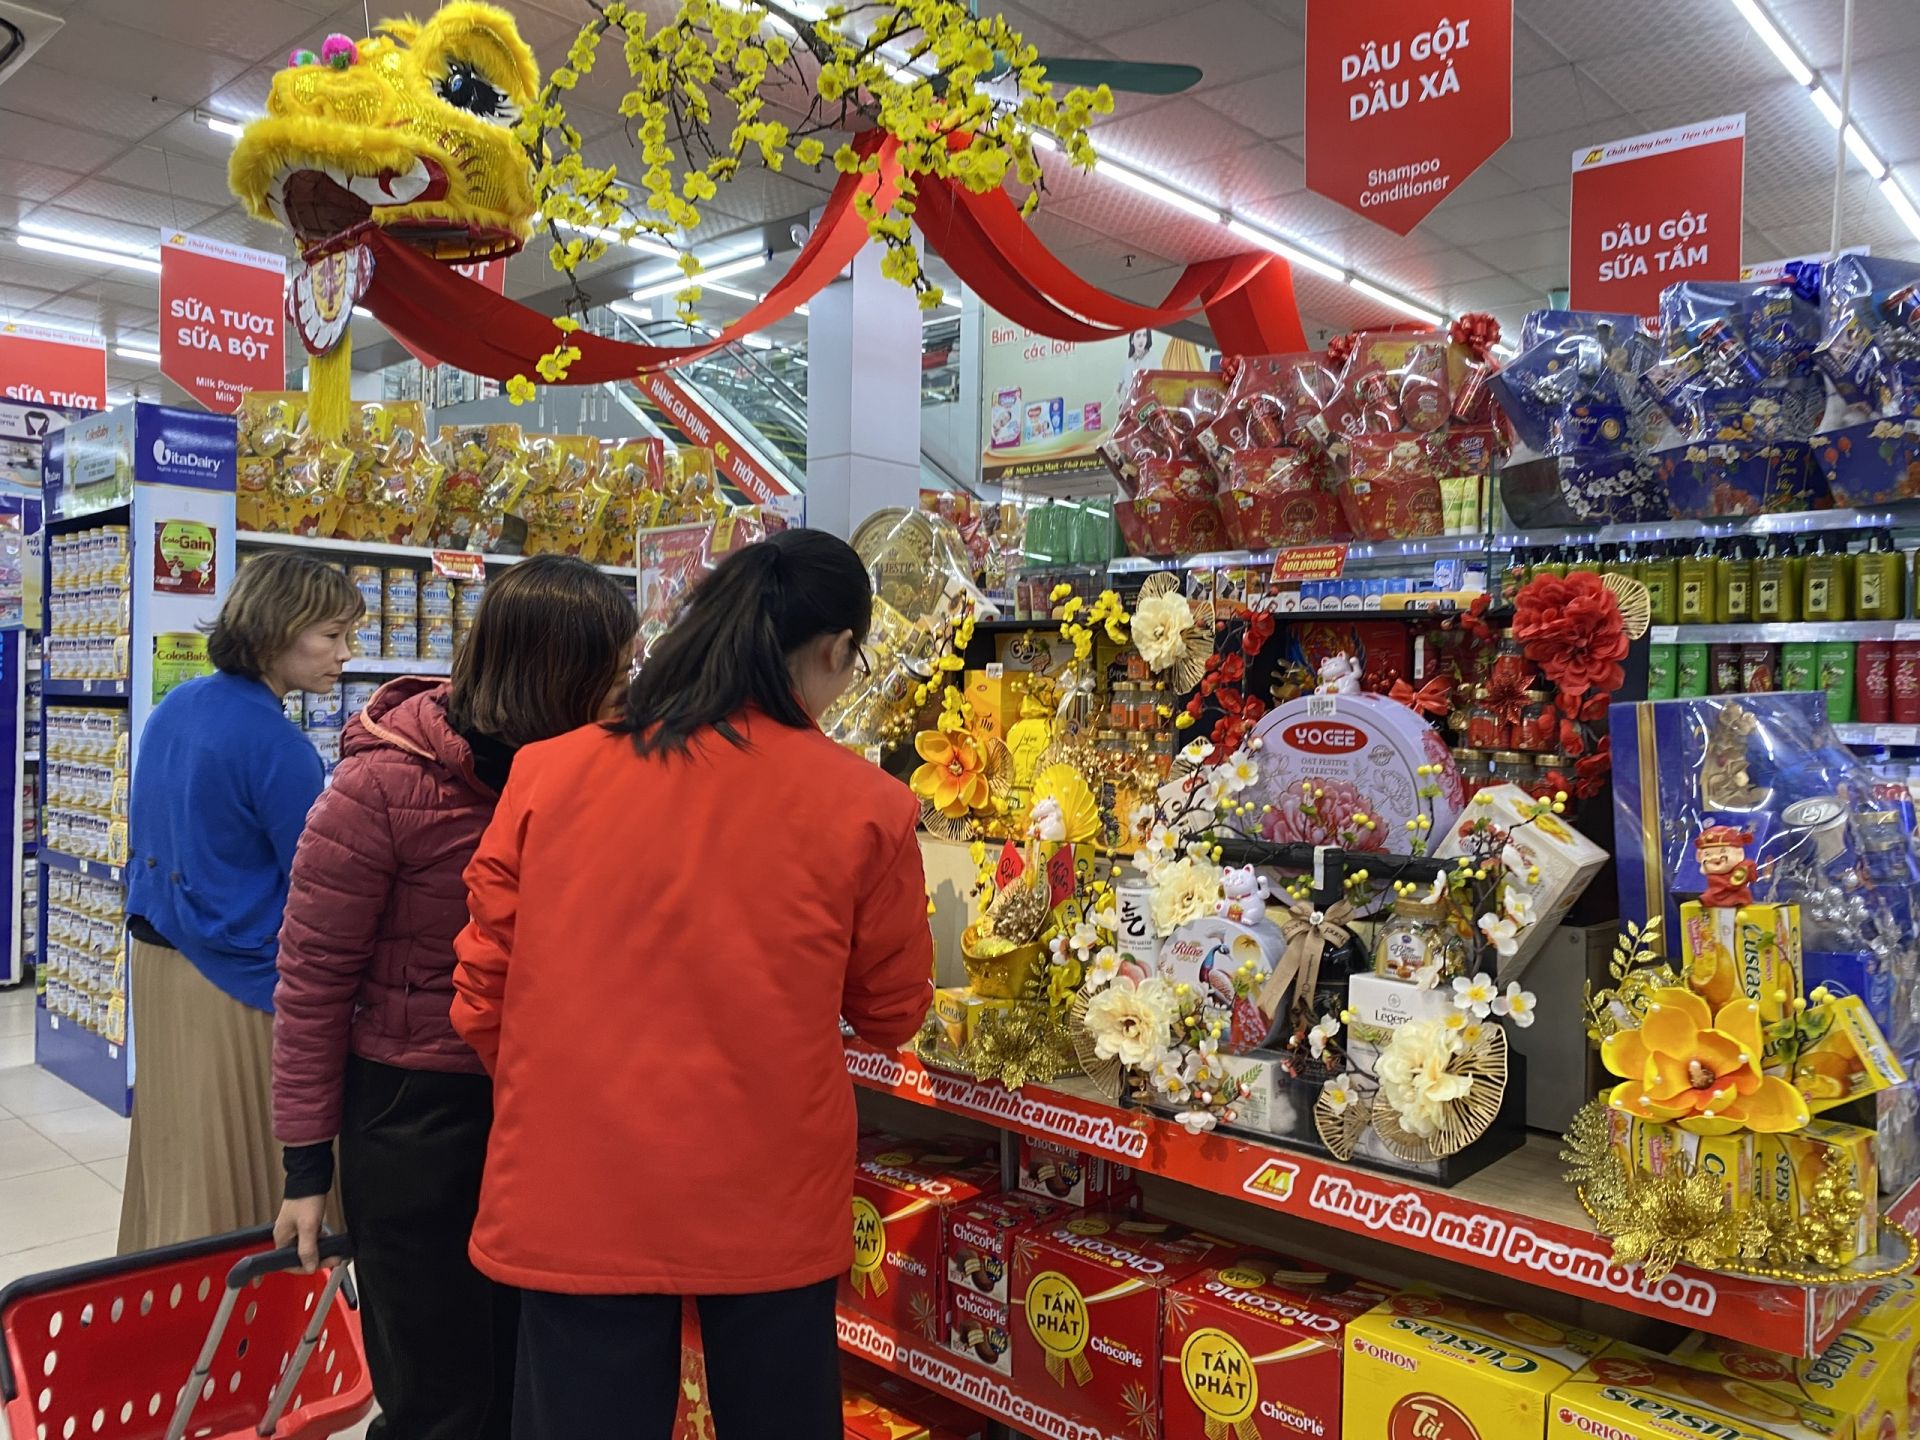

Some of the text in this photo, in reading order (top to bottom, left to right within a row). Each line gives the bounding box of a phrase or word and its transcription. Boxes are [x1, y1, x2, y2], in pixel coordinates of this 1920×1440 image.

[1341, 17, 1470, 83] DẦU GỘI
[1349, 58, 1461, 122] DẦU XẢ
[1368, 157, 1441, 188] Shampoo
[1359, 175, 1451, 208] Conditioner
[1601, 209, 1708, 252] DẦU GỘI
[1598, 243, 1708, 282] SỮA TẮM
[170, 297, 275, 337] SỮA TƯƠI
[178, 325, 270, 362] SỮA BỘT
[1023, 343, 1047, 360] các
[5, 383, 98, 410] SỮA TƯƠI
[196, 375, 254, 393] Milk Powder
[215, 390, 236, 404] Milk
[651, 378, 711, 445] HÀNG GIA DỤNG
[731, 457, 777, 502] THỜI TRAN
[1295, 728, 1356, 747] YOGEE
[1300, 767, 1350, 776] COLLECTION
[1375, 1009, 1413, 1025] Legen
[844, 1049, 905, 1087] motion
[917, 1070, 1148, 1159] www.minhcaumart.vn
[854, 1213, 876, 1235] ẤN
[952, 1222, 1003, 1254] ChocoPie
[853, 1233, 879, 1253] HÁT
[1052, 1230, 1166, 1274] ChocoPie
[1310, 1174, 1431, 1239] Khuyến
[1432, 1210, 1504, 1258] mãi
[1503, 1224, 1717, 1317] Promotion
[886, 1251, 928, 1278] ChocoPie
[955, 1293, 1007, 1327] ChocoPie
[1041, 1290, 1076, 1316] TẤN
[1205, 1281, 1342, 1333] ChocoPie
[1231, 1301, 1280, 1323] ORION
[836, 1315, 896, 1362] motion
[1036, 1312, 1080, 1337] PHÁT
[1090, 1336, 1144, 1369] ChocoPie
[1368, 1346, 1418, 1373] ORION
[1389, 1316, 1542, 1375] Custas
[1424, 1343, 1466, 1362] ORION
[1804, 1331, 1877, 1390] Custas
[1201, 1349, 1242, 1378] TẤN
[1195, 1372, 1247, 1401] PHÁT
[1259, 1400, 1325, 1437] ChocoPie
[1598, 1386, 1767, 1440] ustas
